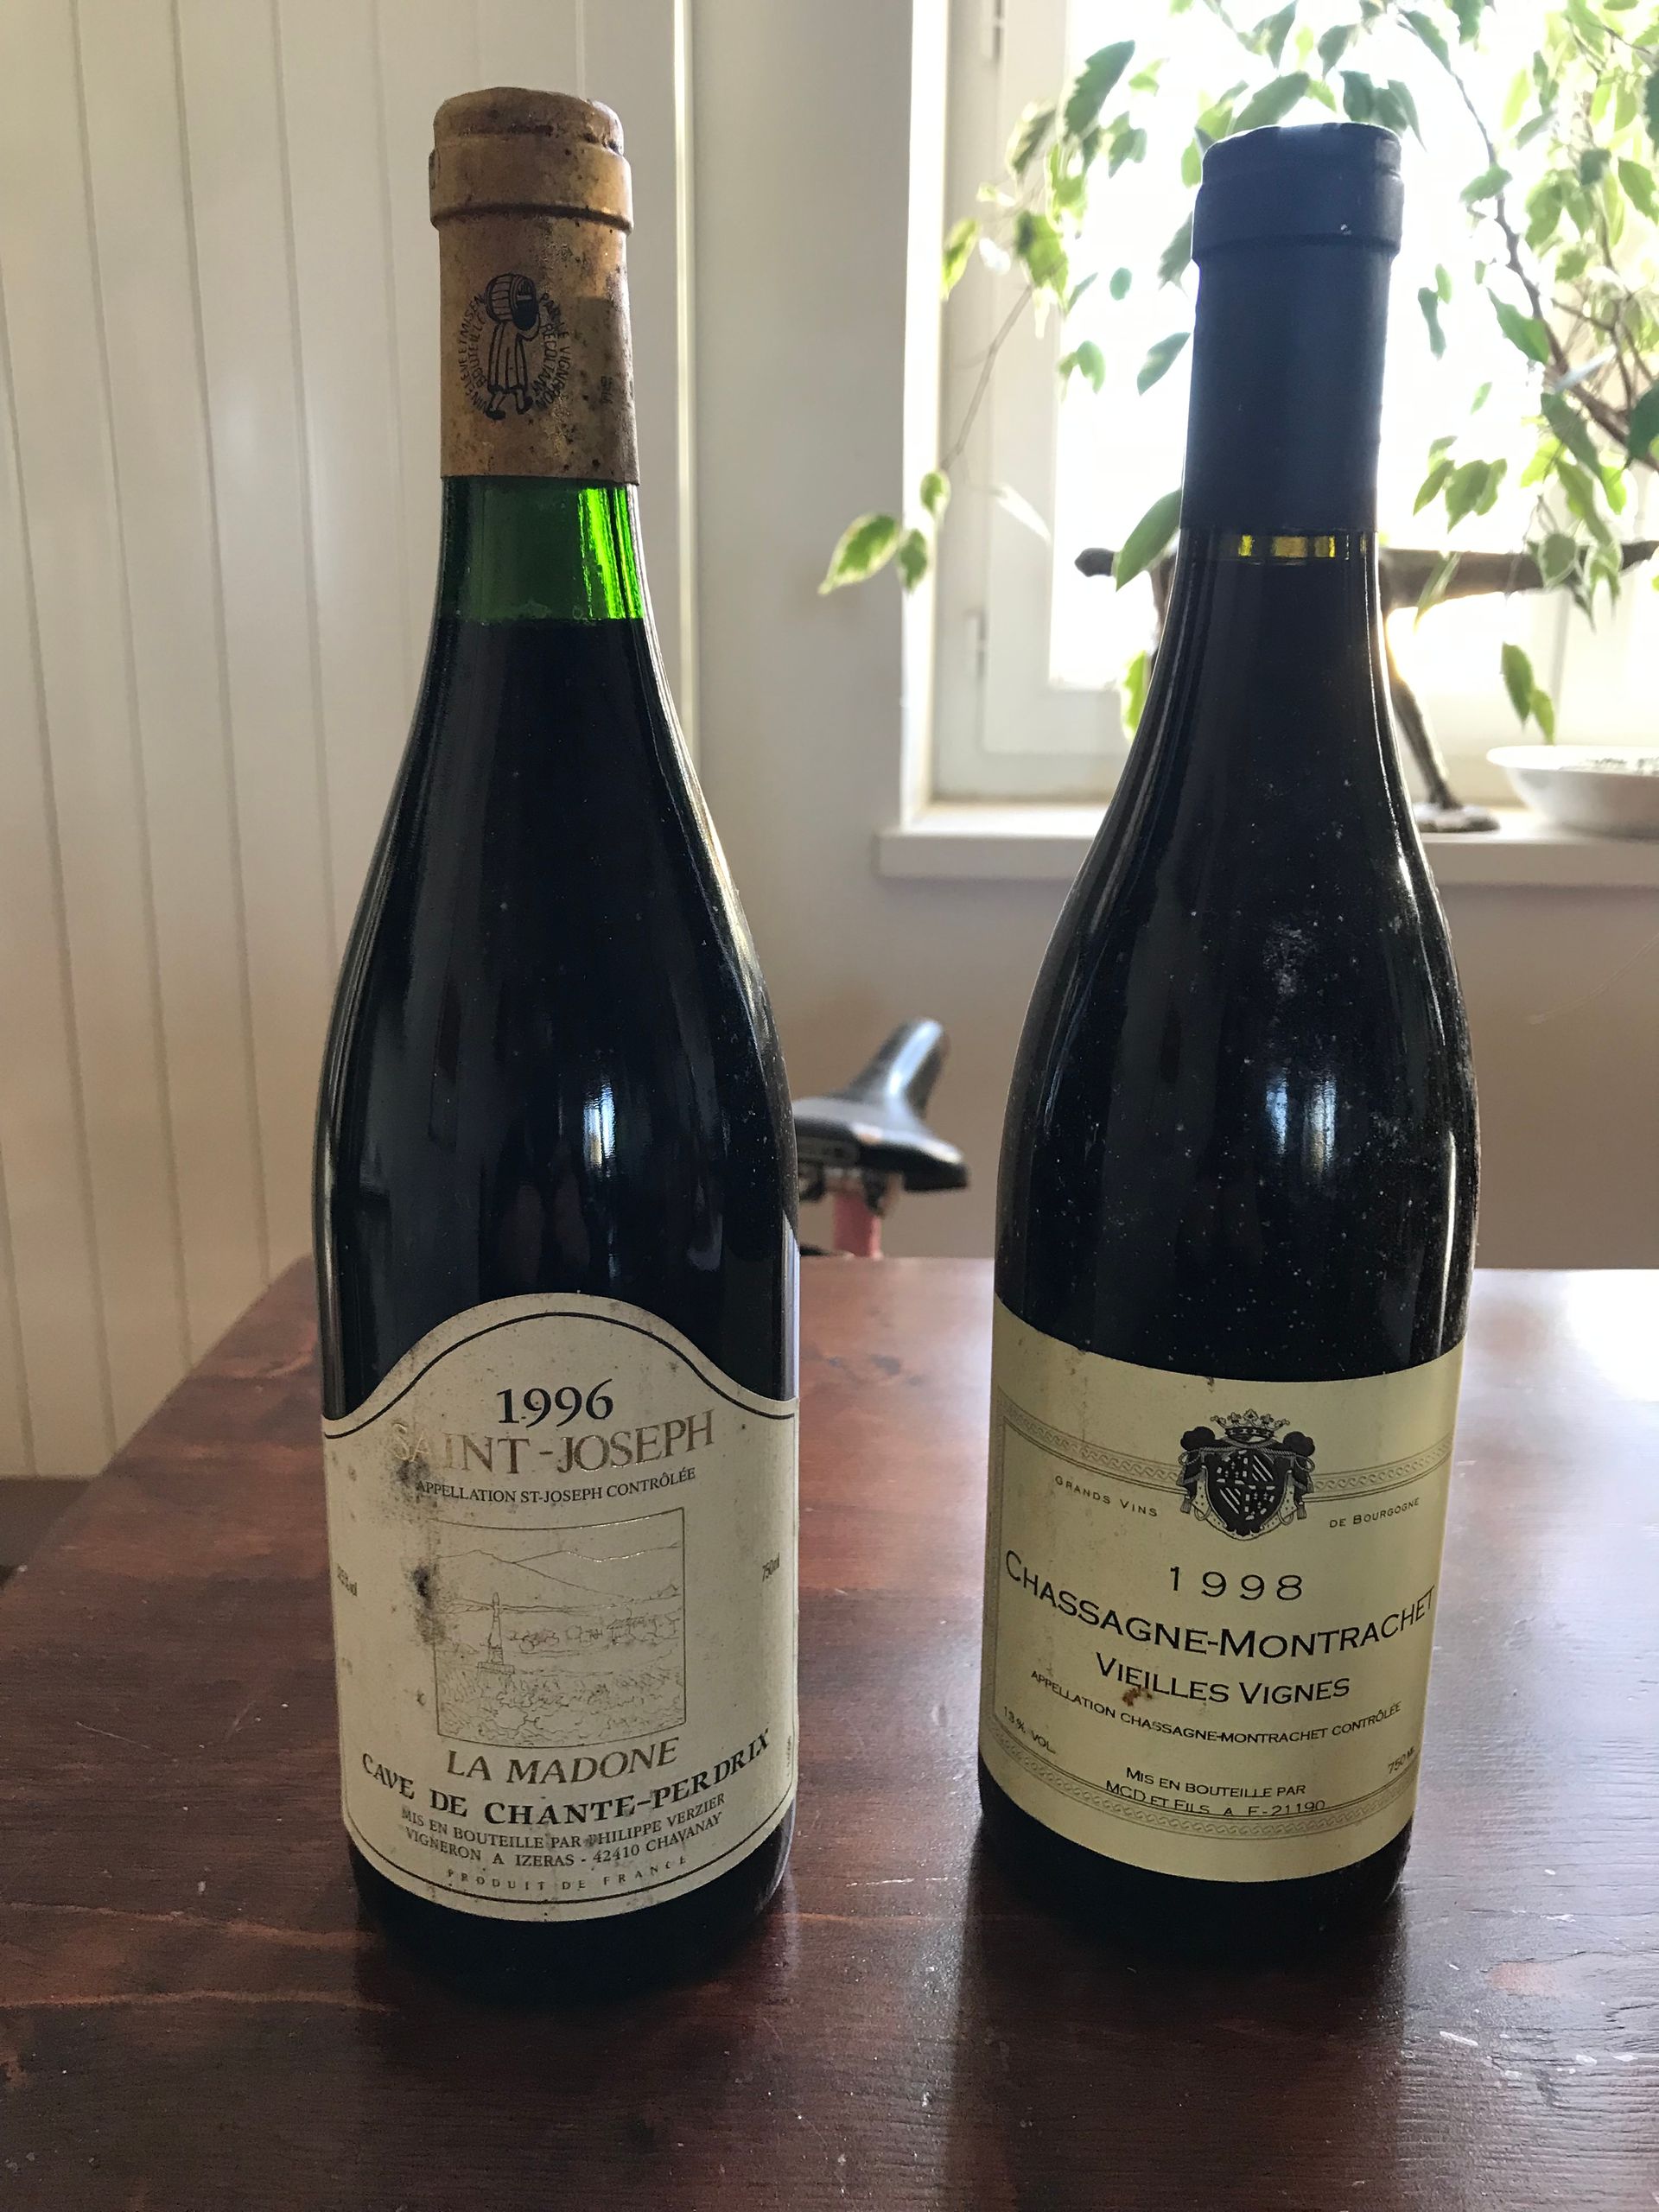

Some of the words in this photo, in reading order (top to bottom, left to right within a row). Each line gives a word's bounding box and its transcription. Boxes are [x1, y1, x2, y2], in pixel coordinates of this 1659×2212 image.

[496, 1377, 614, 1428] 1996
[416, 1479, 516, 1503] APPELLATION
[519, 1484, 603, 1504] ST-JOSEPH
[607, 1465, 696, 1498] CONTRÔLÉE
[1054, 1474, 1112, 1508] GRANDS
[1119, 1499, 1159, 1518] VINS
[1329, 1518, 1346, 1529] DE
[1353, 1497, 1421, 1525] BOURGOGNE
[1004, 1549, 1436, 1660] CHASSAGNE-MONTRACHET
[1168, 1565, 1304, 1602] 1998
[1096, 1651, 1230, 1704] VIEILLES
[1239, 1677, 1351, 1705] VIGNES
[1030, 1670, 1116, 1719] APPELLATION
[1120, 1713, 1329, 1745] CHASSAGNE-MONTRACHET
[1331, 1699, 1403, 1738] CONTRÔLÉE
[360, 1752, 416, 1801] CAVE
[429, 1788, 467, 1817] DE
[484, 1727, 772, 1825] CHANTE-PERDRIX
[446, 1749, 491, 1782] LA
[506, 1736, 680, 1784] MADONE
[1126, 1766, 1154, 1786] MIS
[1159, 1776, 1180, 1791] EN
[1185, 1783, 1273, 1798] BOUTEILLE
[1276, 1784, 1306, 1796] PAR
[401, 1806, 424, 1827] MIS
[429, 1819, 448, 1834] EN
[454, 1827, 543, 1848] BOUTEILLE
[550, 1835, 582, 1848] PAR
[666, 1793, 725, 1827] VERZIER
[404, 1827, 482, 1861] VIGNERON
[492, 1853, 505, 1865] A
[515, 1853, 575, 1866] IZERAS
[593, 1844, 640, 1863] 42410
[646, 1811, 722, 1852] CHAVANAY
[447, 1869, 545, 1891] PRODUIT
[562, 1880, 587, 1890] DE
[603, 1855, 687, 1885] FRANCE
